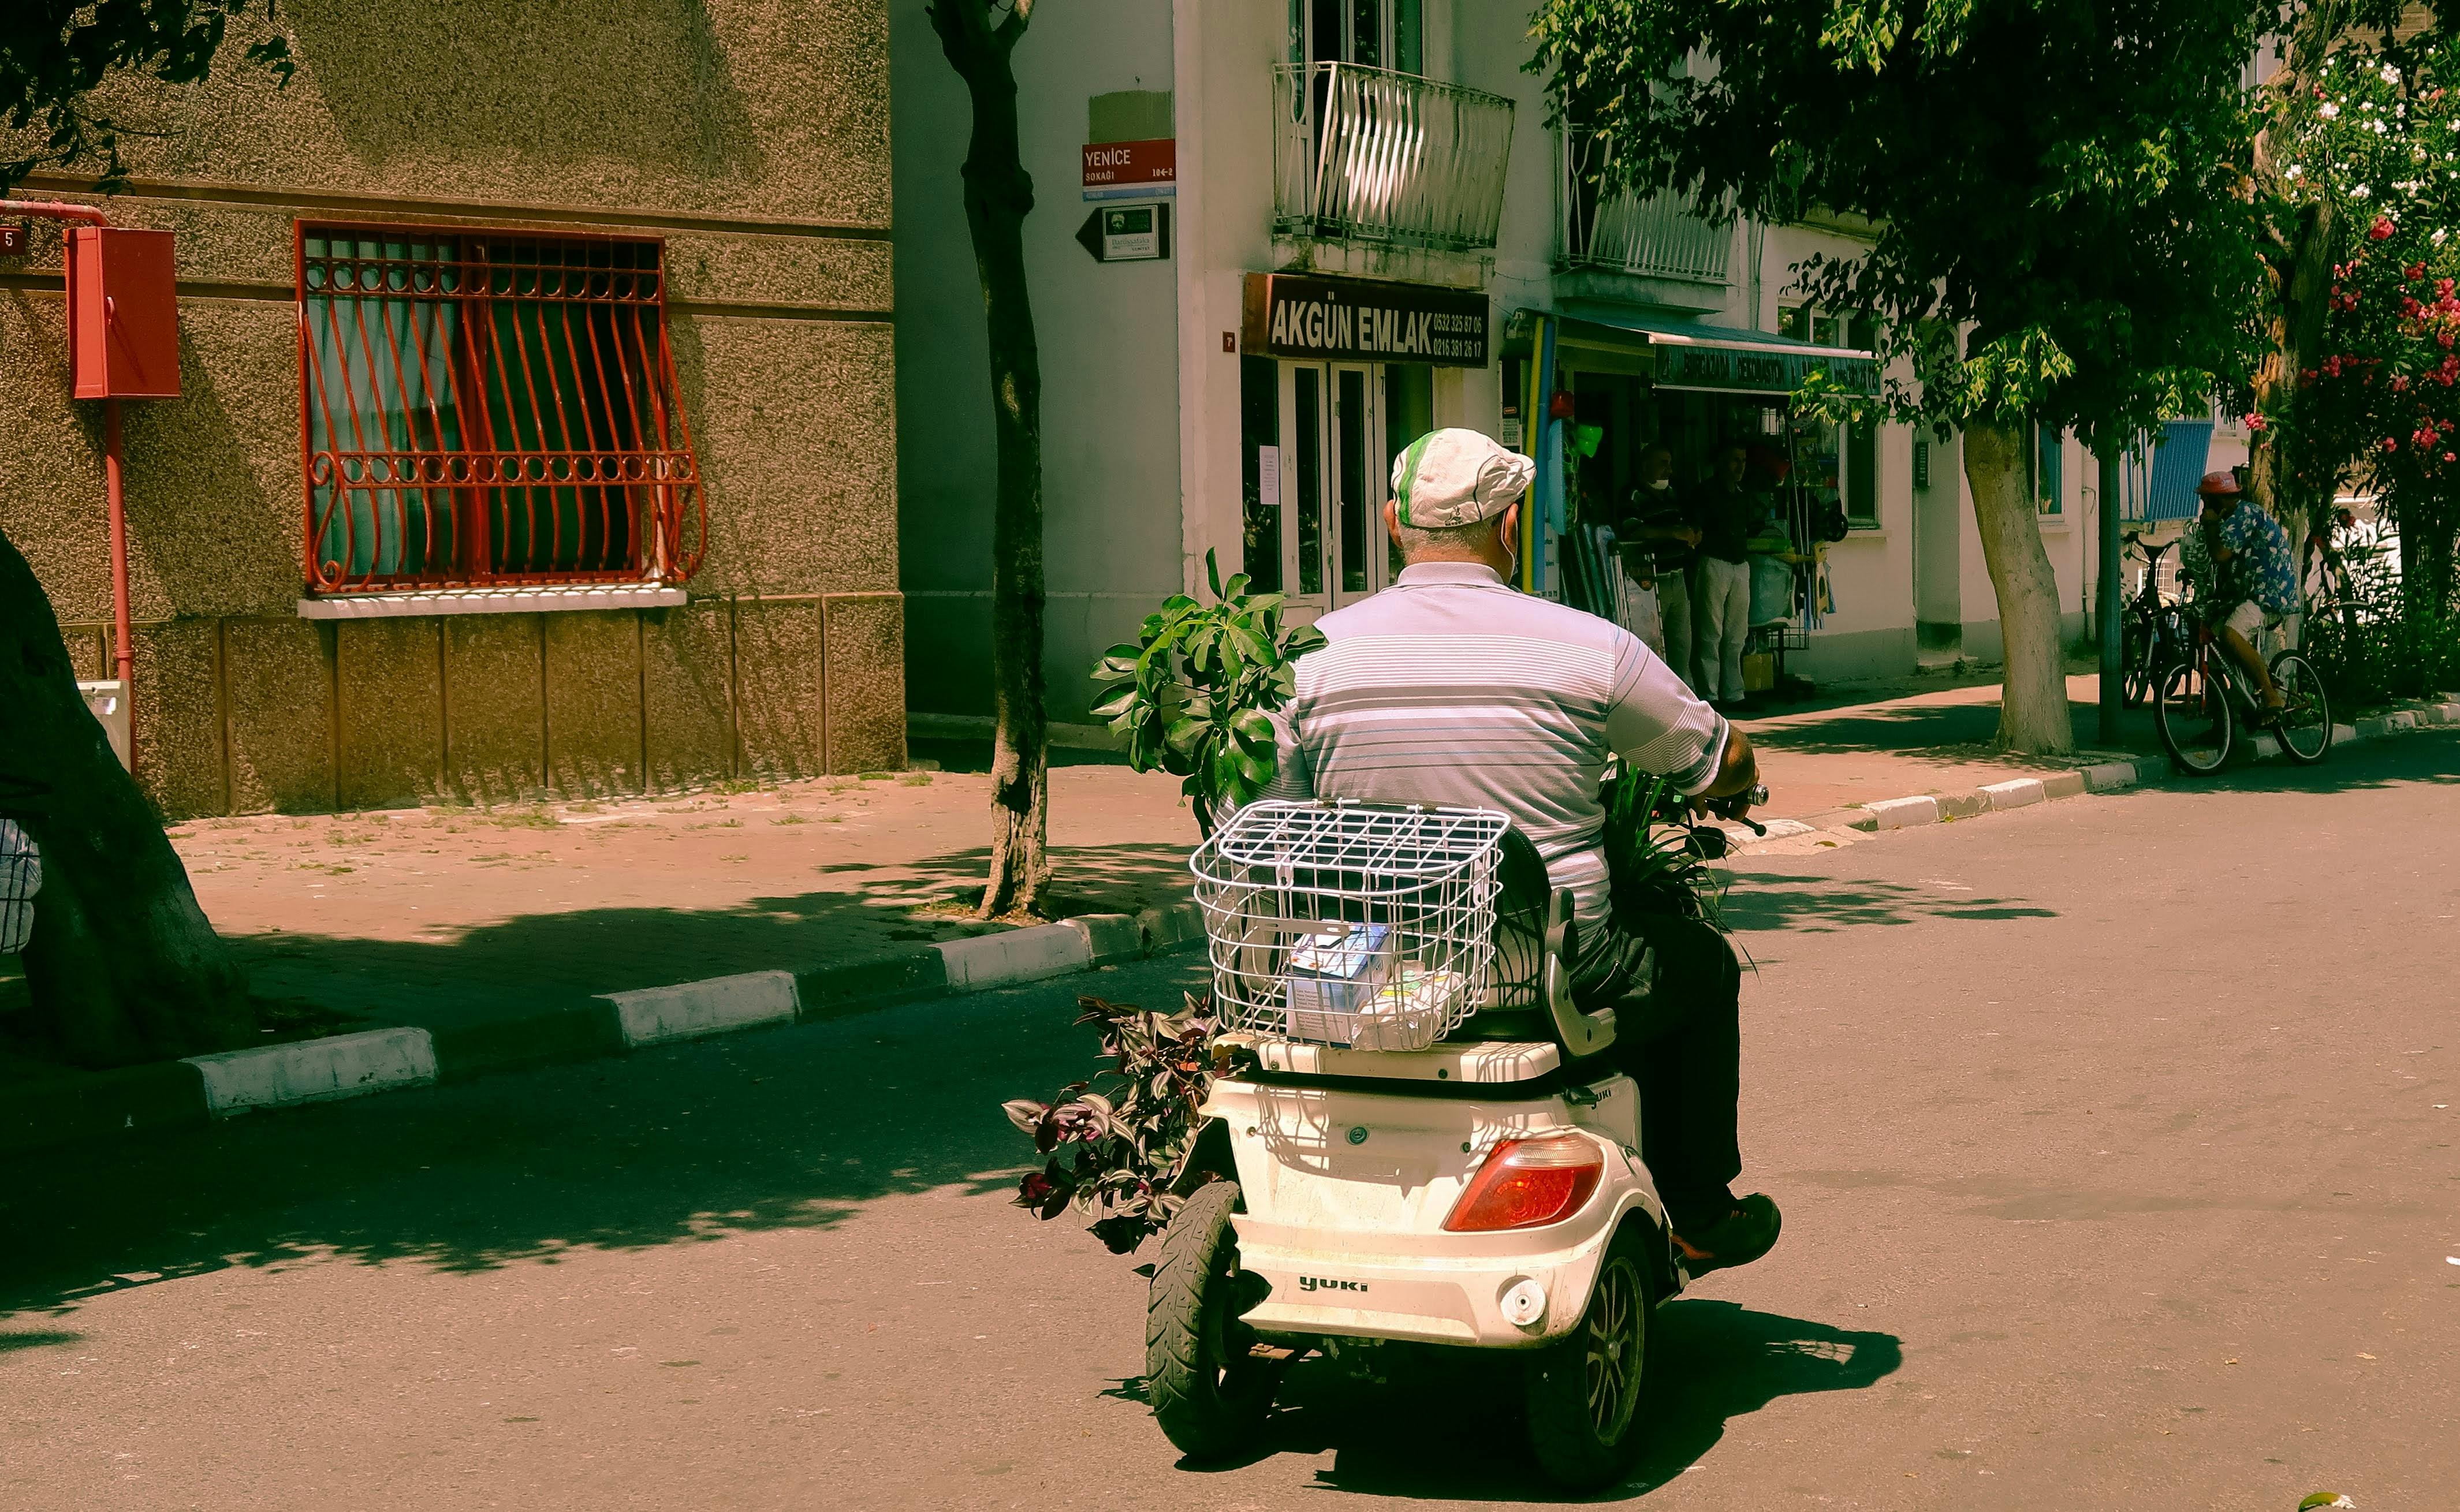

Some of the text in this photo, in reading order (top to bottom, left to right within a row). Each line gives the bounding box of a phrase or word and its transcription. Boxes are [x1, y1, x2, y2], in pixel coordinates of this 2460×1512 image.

[1085, 147, 1131, 167] YENİCE
[1085, 170, 1115, 181] SOKAĞI
[5, 232, 13, 247] 5
[1272, 292, 1433, 354] AKGÜN EMLAK
[1433, 312, 1482, 334] 0532 325 87 06
[1433, 337, 1450, 357] 0216
[1464, 339, 1473, 358] 26
[1474, 340, 1482, 358] 17
